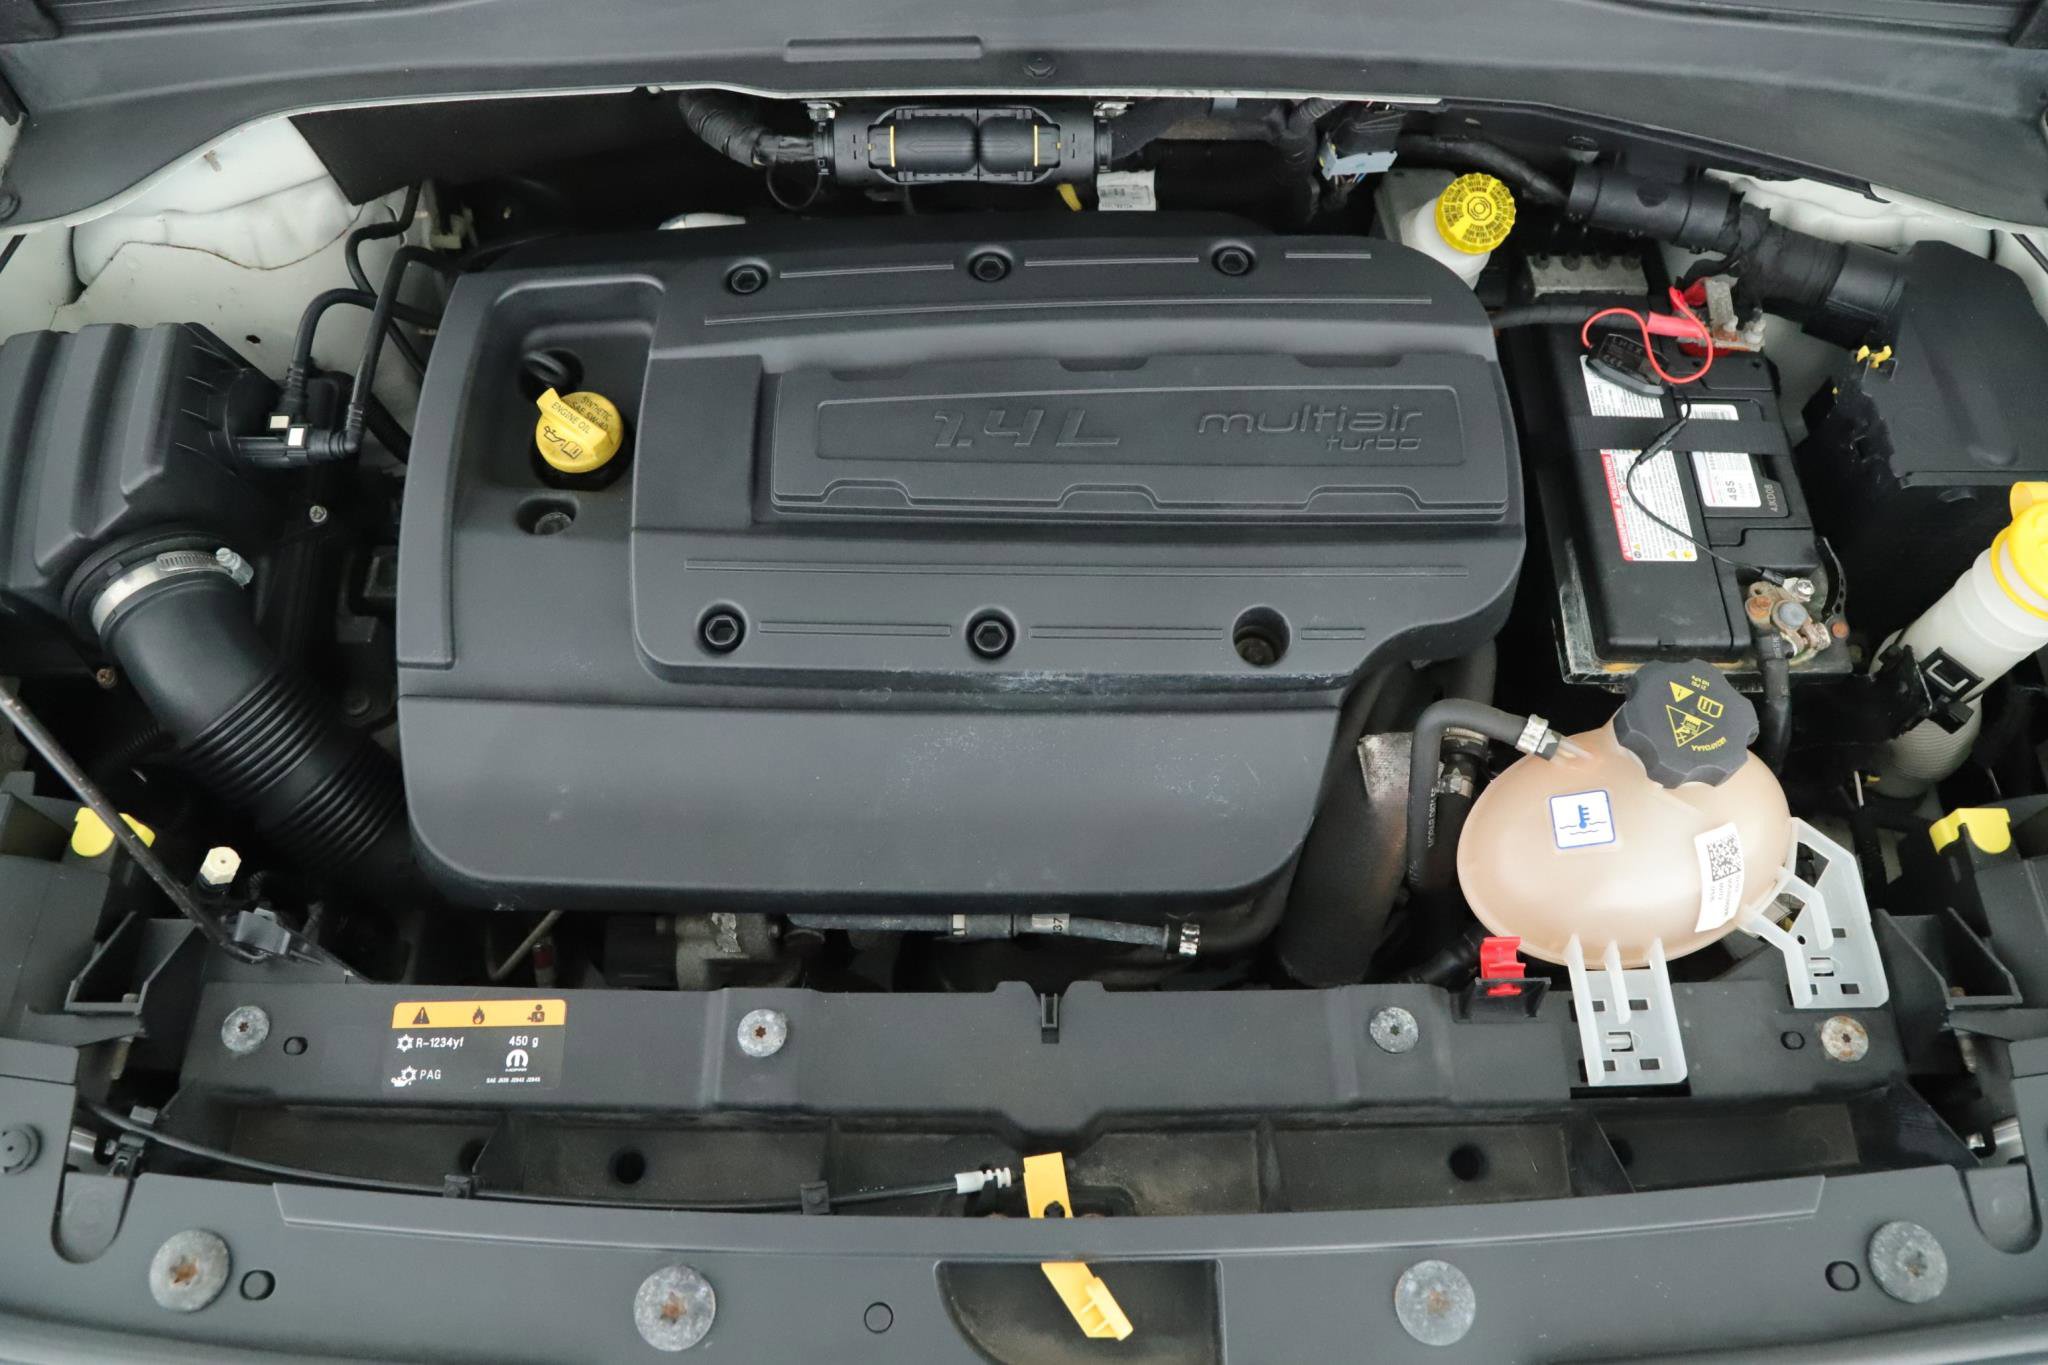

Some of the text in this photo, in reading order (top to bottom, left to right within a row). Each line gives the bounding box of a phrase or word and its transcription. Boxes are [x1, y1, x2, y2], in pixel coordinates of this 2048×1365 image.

[552, 402, 592, 434] ENGINE OIL
[1199, 404, 1424, 433] multiair
[1326, 434, 1423, 451] turbo
[415, 1036, 465, 1050] R-1234yf
[508, 1035, 540, 1048] 450 g
[419, 1069, 442, 1080] PAG
